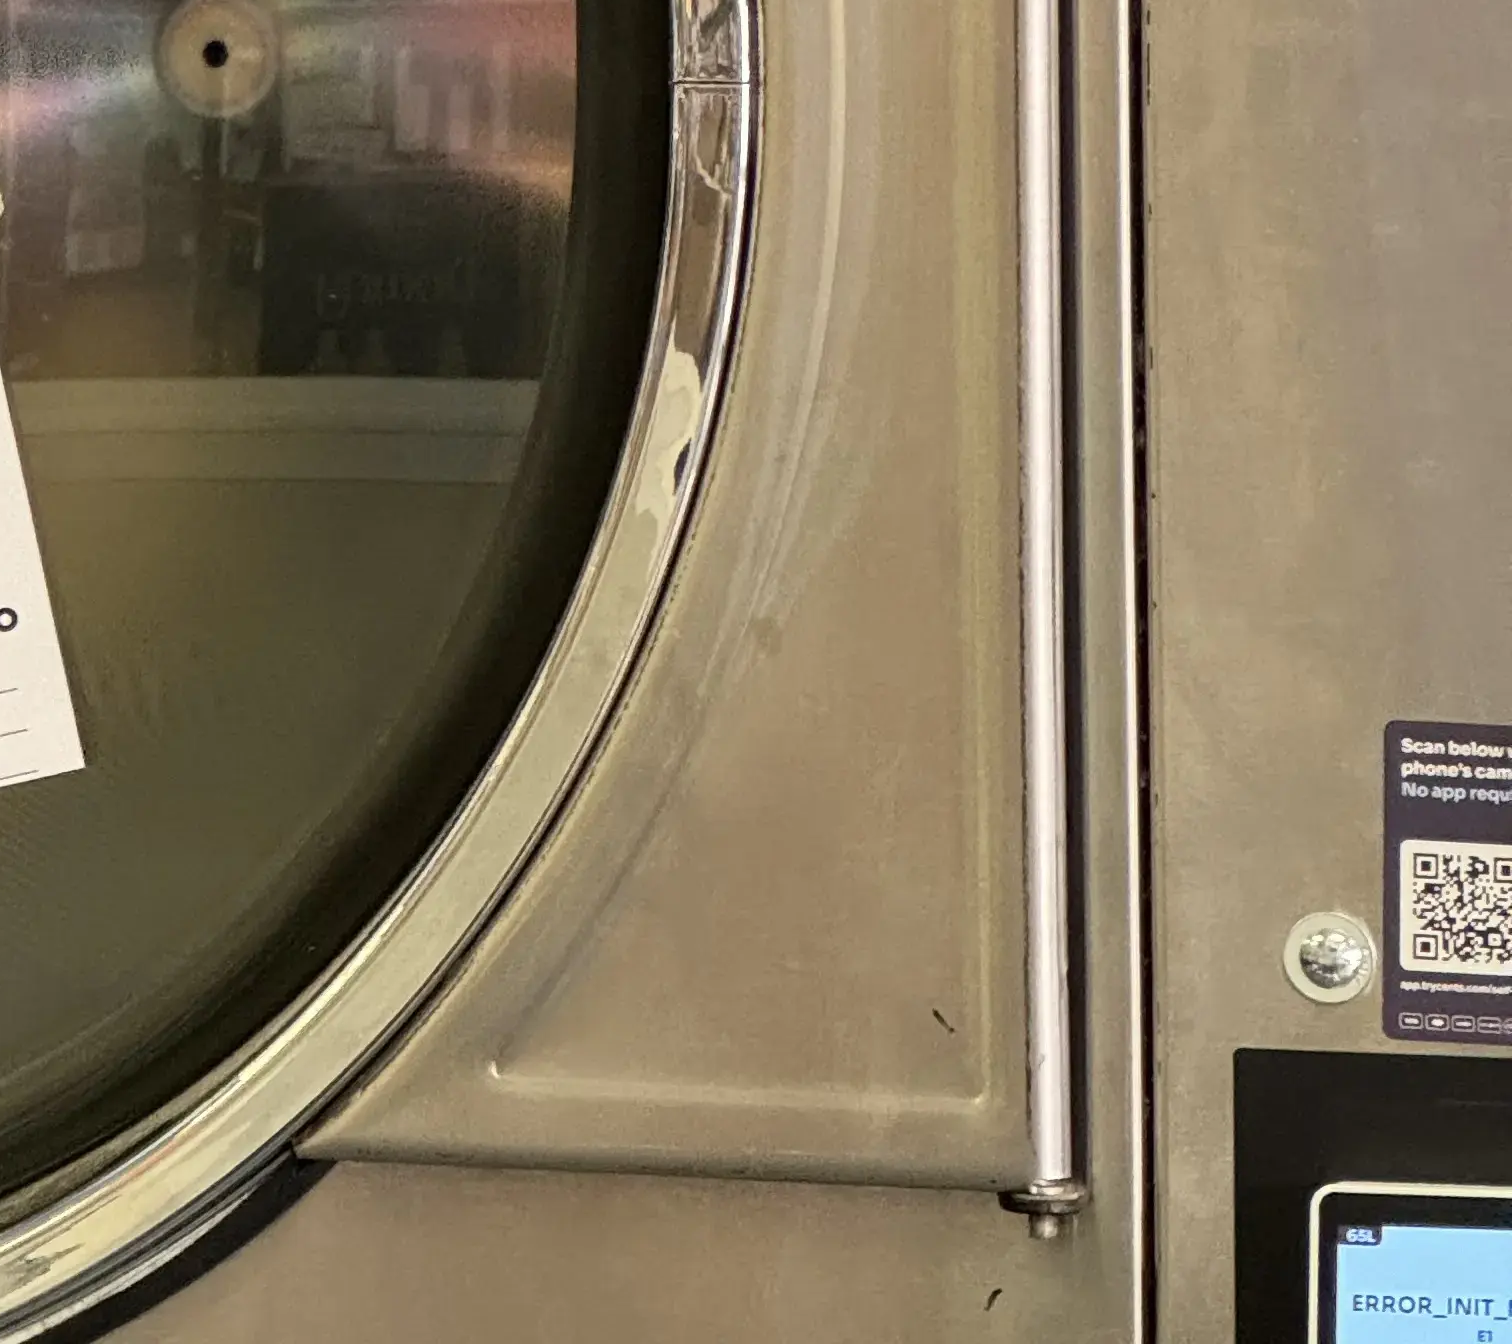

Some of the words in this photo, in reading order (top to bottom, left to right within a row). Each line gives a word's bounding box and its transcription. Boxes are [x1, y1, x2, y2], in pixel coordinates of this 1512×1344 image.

[1400, 737, 1445, 754] Scan
[1448, 740, 1505, 758] below
[1400, 760, 1473, 779] phone's
[1401, 781, 1429, 798] No
[1431, 786, 1467, 804] app
[1352, 1294, 1512, 1321] ERROR_INIT_
